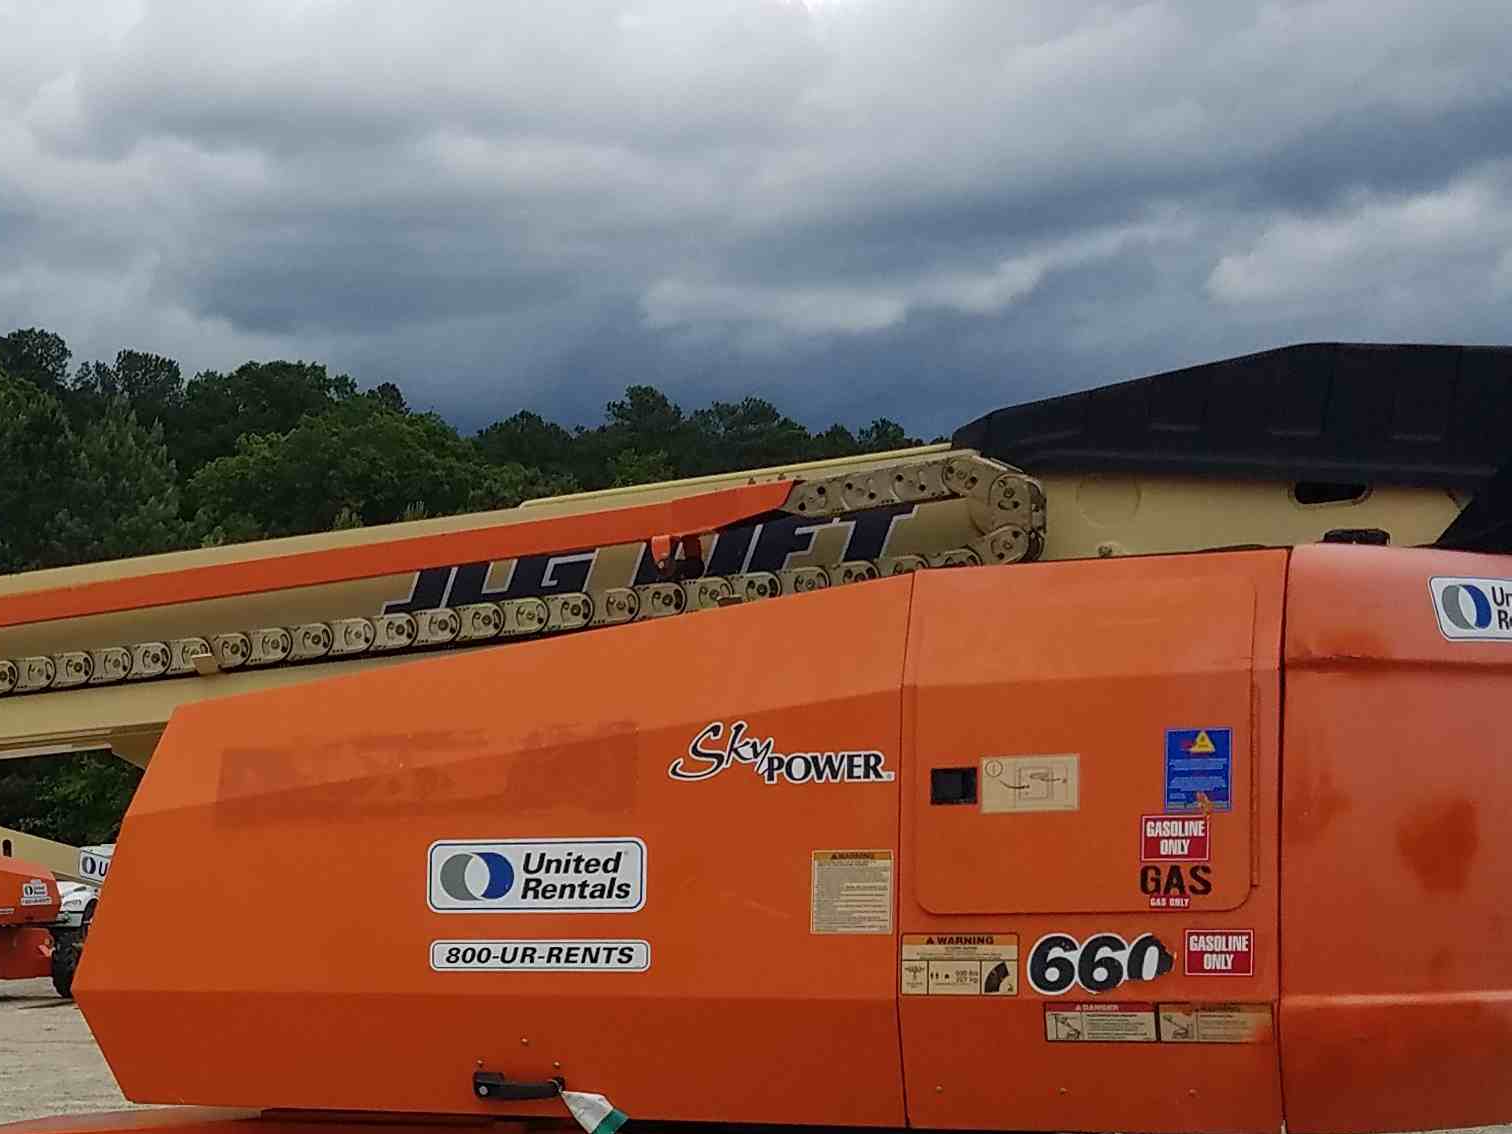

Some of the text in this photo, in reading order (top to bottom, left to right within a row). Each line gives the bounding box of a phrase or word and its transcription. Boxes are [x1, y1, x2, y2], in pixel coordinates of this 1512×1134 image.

[670, 723, 884, 782] Sky POWER
[1145, 821, 1206, 838] GASOLINE
[1159, 839, 1190, 856] ONLY
[523, 851, 623, 874] United
[521, 877, 631, 899] Rentals
[1140, 864, 1212, 895] GAS
[1150, 898, 1189, 907] GAS ONLY
[937, 935, 994, 945] WARNING
[1189, 935, 1249, 952] GASOLINE
[445, 947, 635, 965] 800-UR-RENTS
[1029, 934, 1175, 994] 660
[1203, 952, 1234, 970] ONLY
